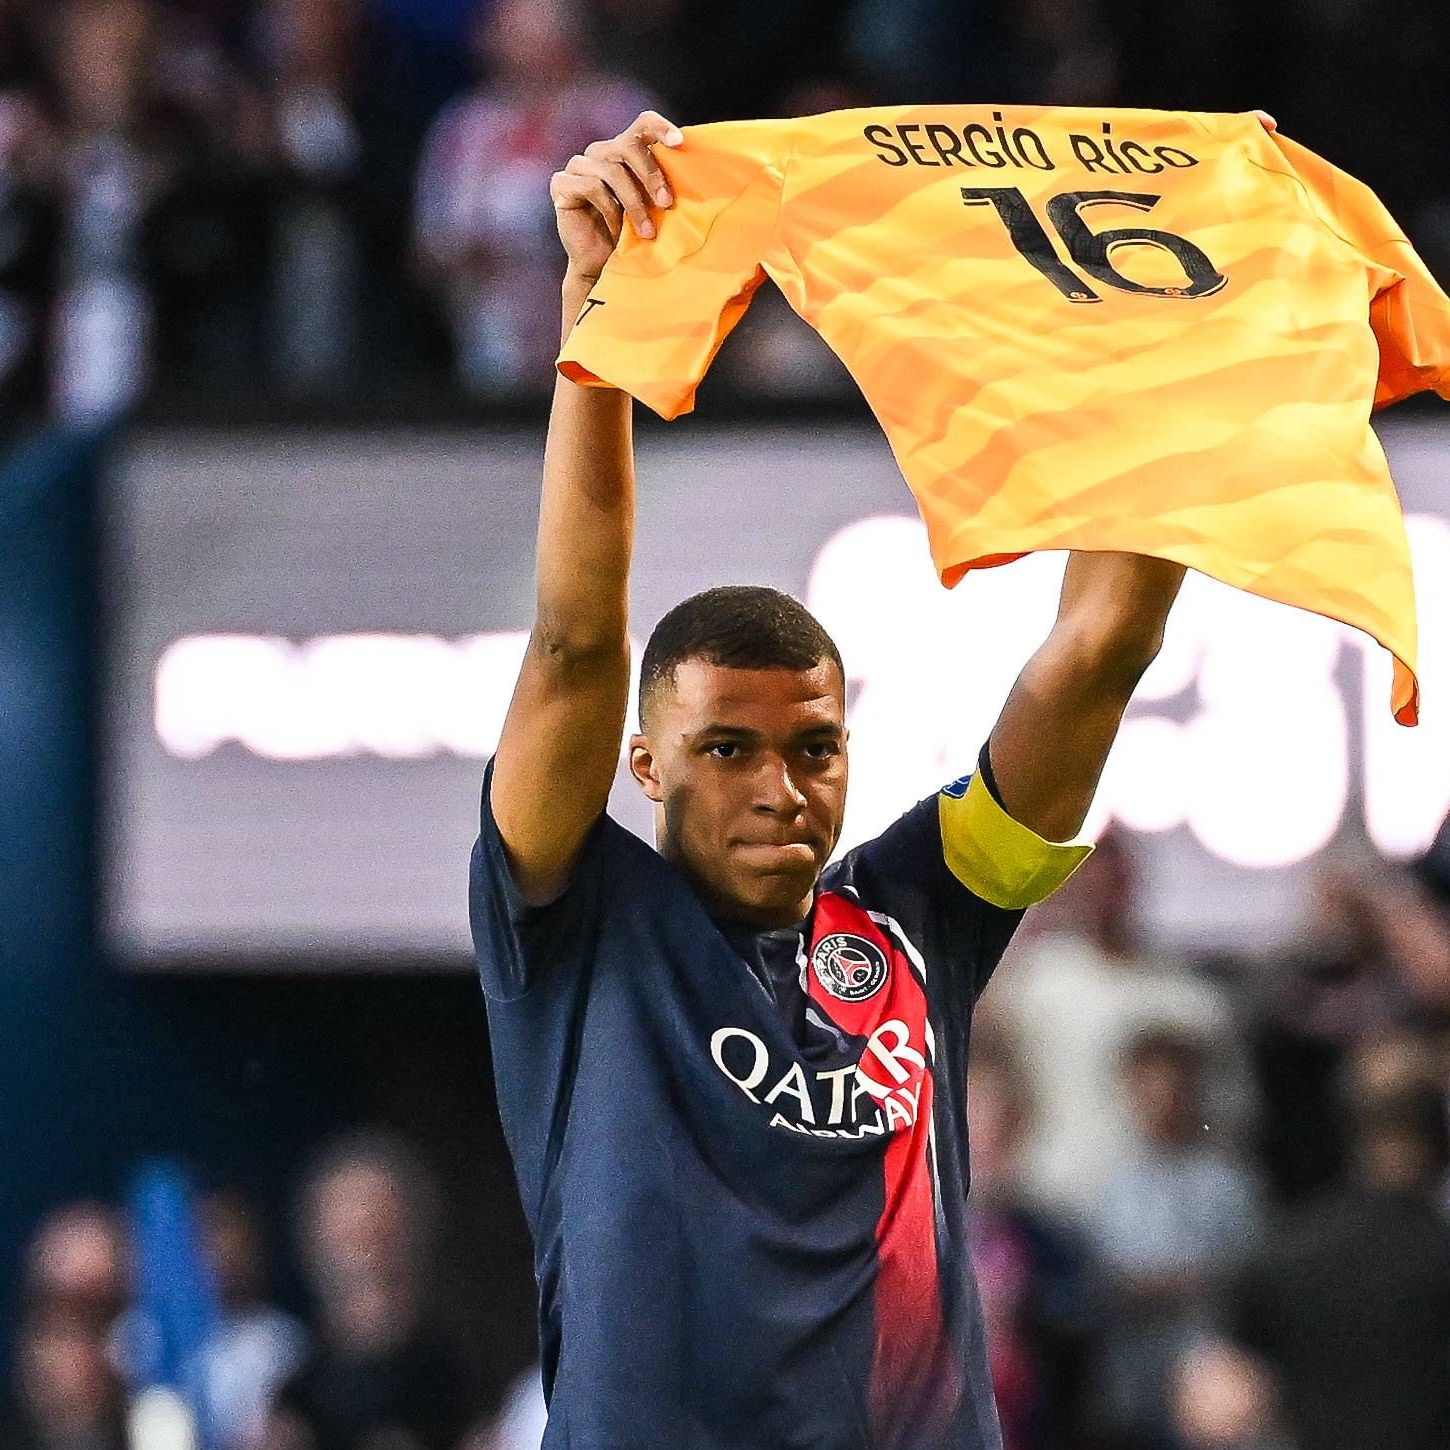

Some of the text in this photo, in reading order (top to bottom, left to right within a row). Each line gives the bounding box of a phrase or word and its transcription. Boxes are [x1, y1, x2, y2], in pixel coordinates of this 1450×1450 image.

[960, 186, 1228, 303] 16
[816, 936, 847, 973] PARIS
[710, 1019, 926, 1125] QATAR
